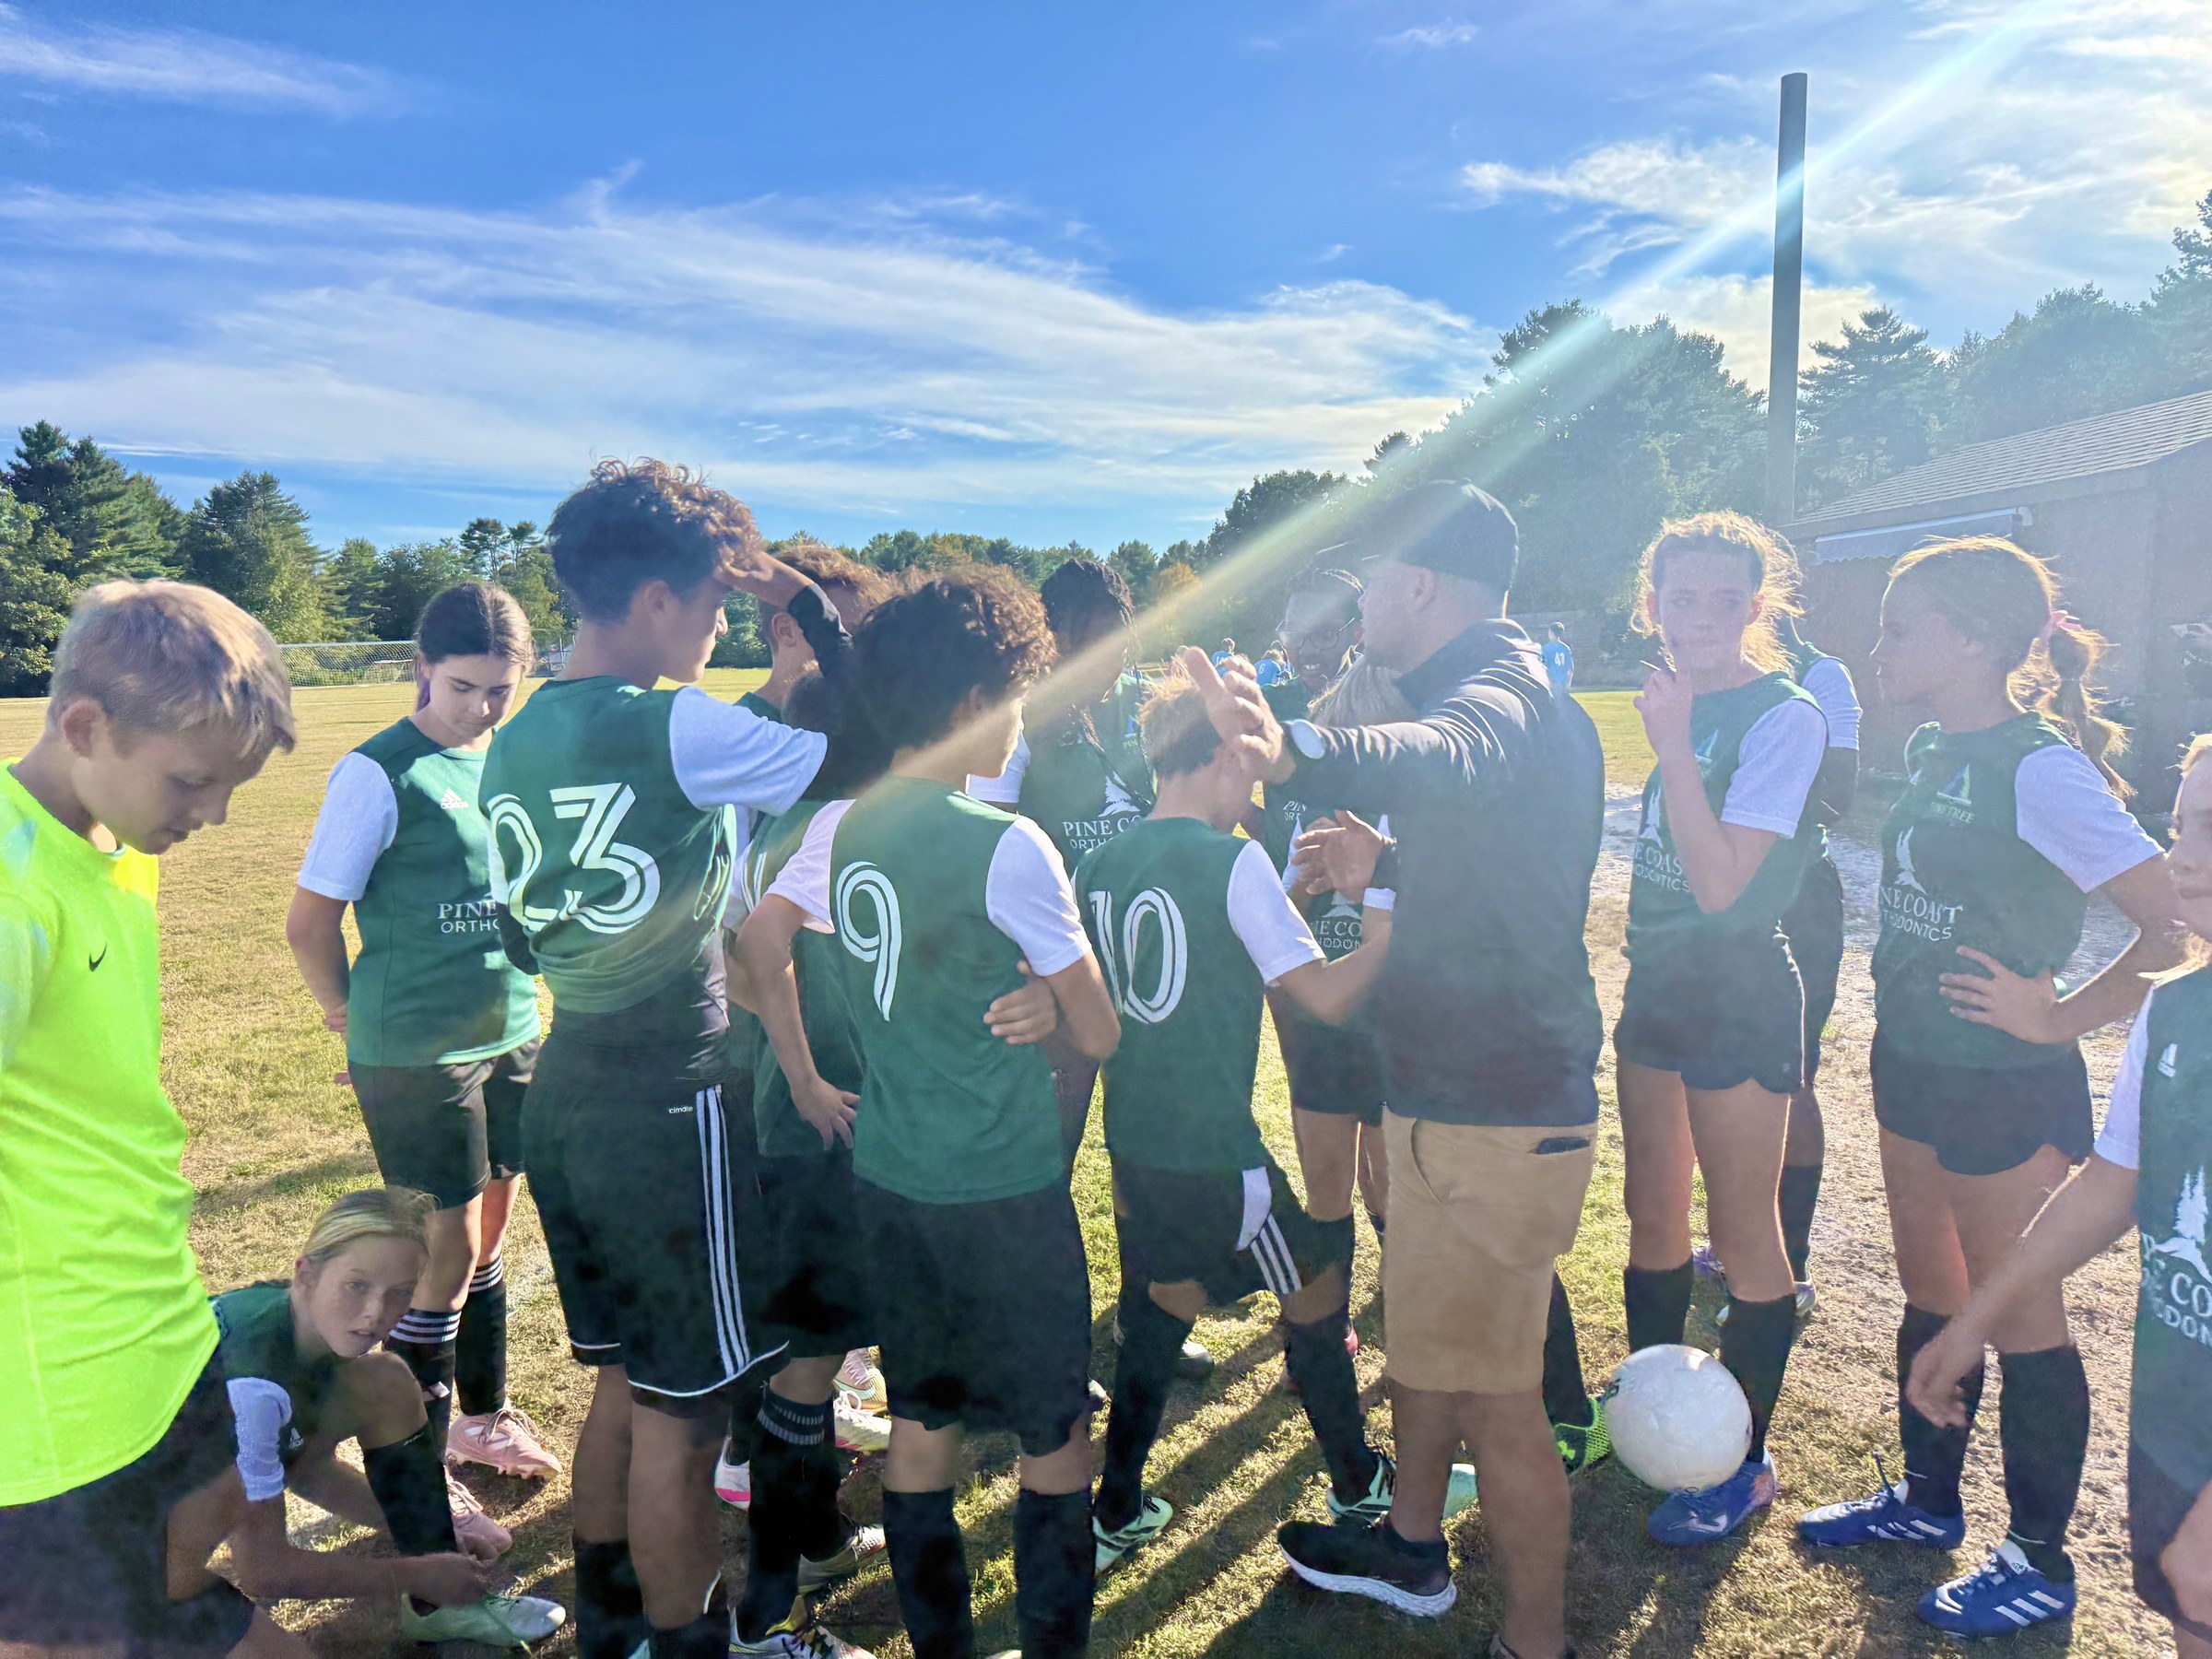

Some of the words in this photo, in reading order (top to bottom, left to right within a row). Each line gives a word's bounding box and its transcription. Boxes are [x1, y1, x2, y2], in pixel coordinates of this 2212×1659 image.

[1062, 819, 1112, 837] PINE
[1069, 837, 1113, 850] ORTH
[438, 900, 498, 919] PINE
[1334, 921, 1362, 937] CO
[836, 861, 902, 1022] 9
[1088, 887, 1188, 1025] 10
